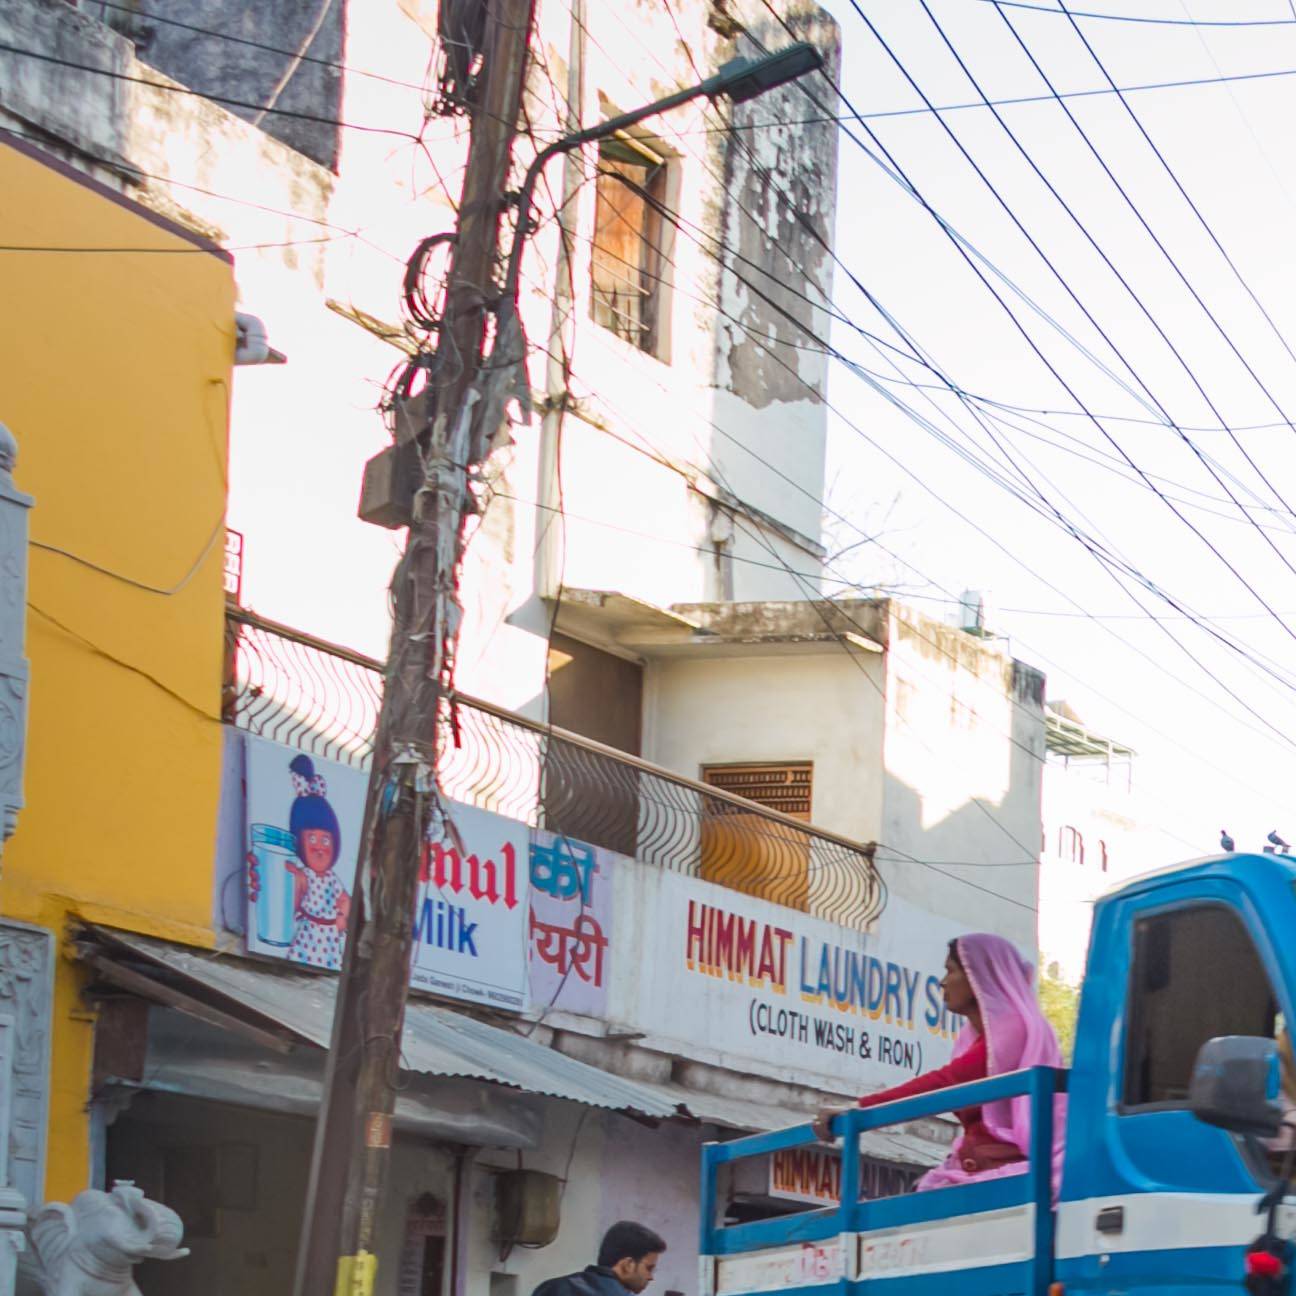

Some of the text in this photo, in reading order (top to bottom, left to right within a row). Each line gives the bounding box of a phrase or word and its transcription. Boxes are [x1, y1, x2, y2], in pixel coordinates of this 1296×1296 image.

[419, 840, 519, 910] mul
[529, 905, 608, 988] यरी
[686, 899, 793, 991] HIMMAT
[800, 936, 921, 1029] LAUNDRY
[750, 998, 922, 1076] (CLOTH WASH & IRON)
